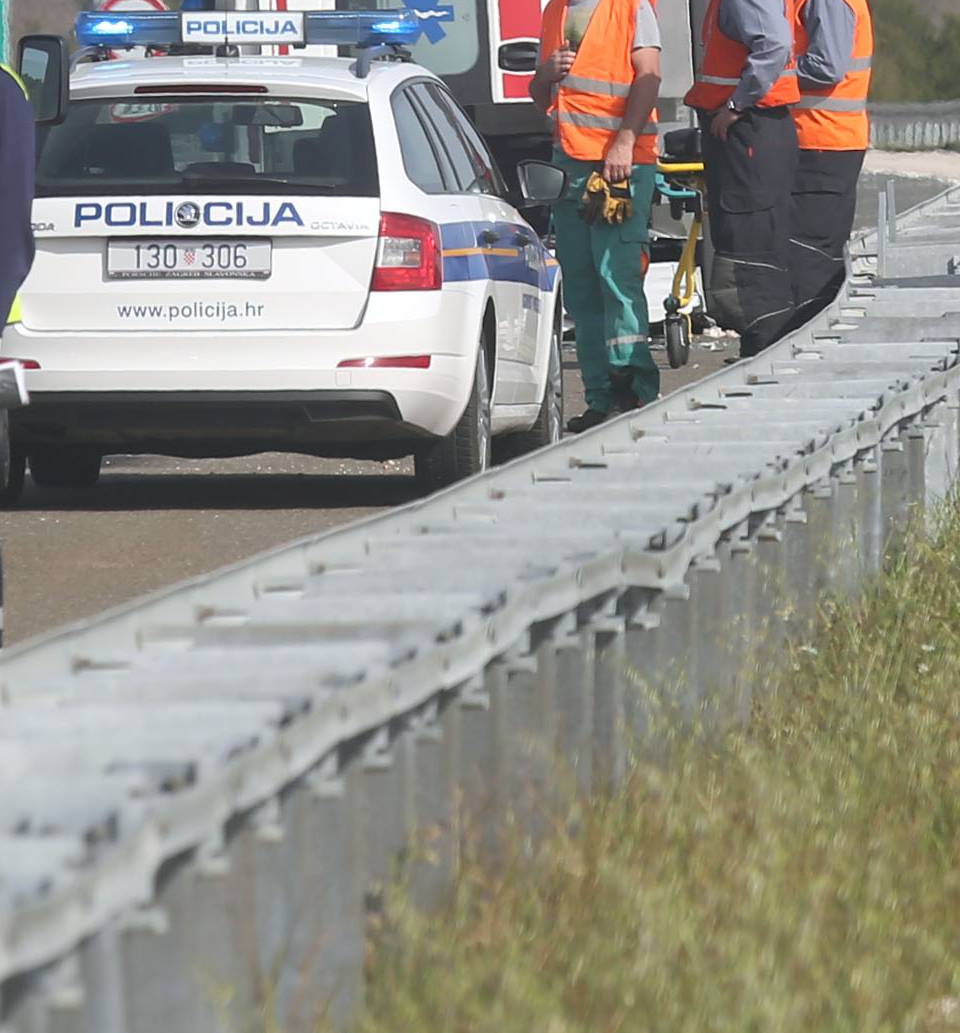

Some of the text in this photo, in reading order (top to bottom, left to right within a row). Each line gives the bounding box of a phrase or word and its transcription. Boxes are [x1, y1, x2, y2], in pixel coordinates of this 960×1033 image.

[186, 20, 298, 35] POLICIJA
[74, 201, 304, 228] POLICIJA
[310, 220, 371, 231] OCTAVIA
[134, 243, 248, 269] 130 306
[117, 301, 264, 322] www.policija.hr
